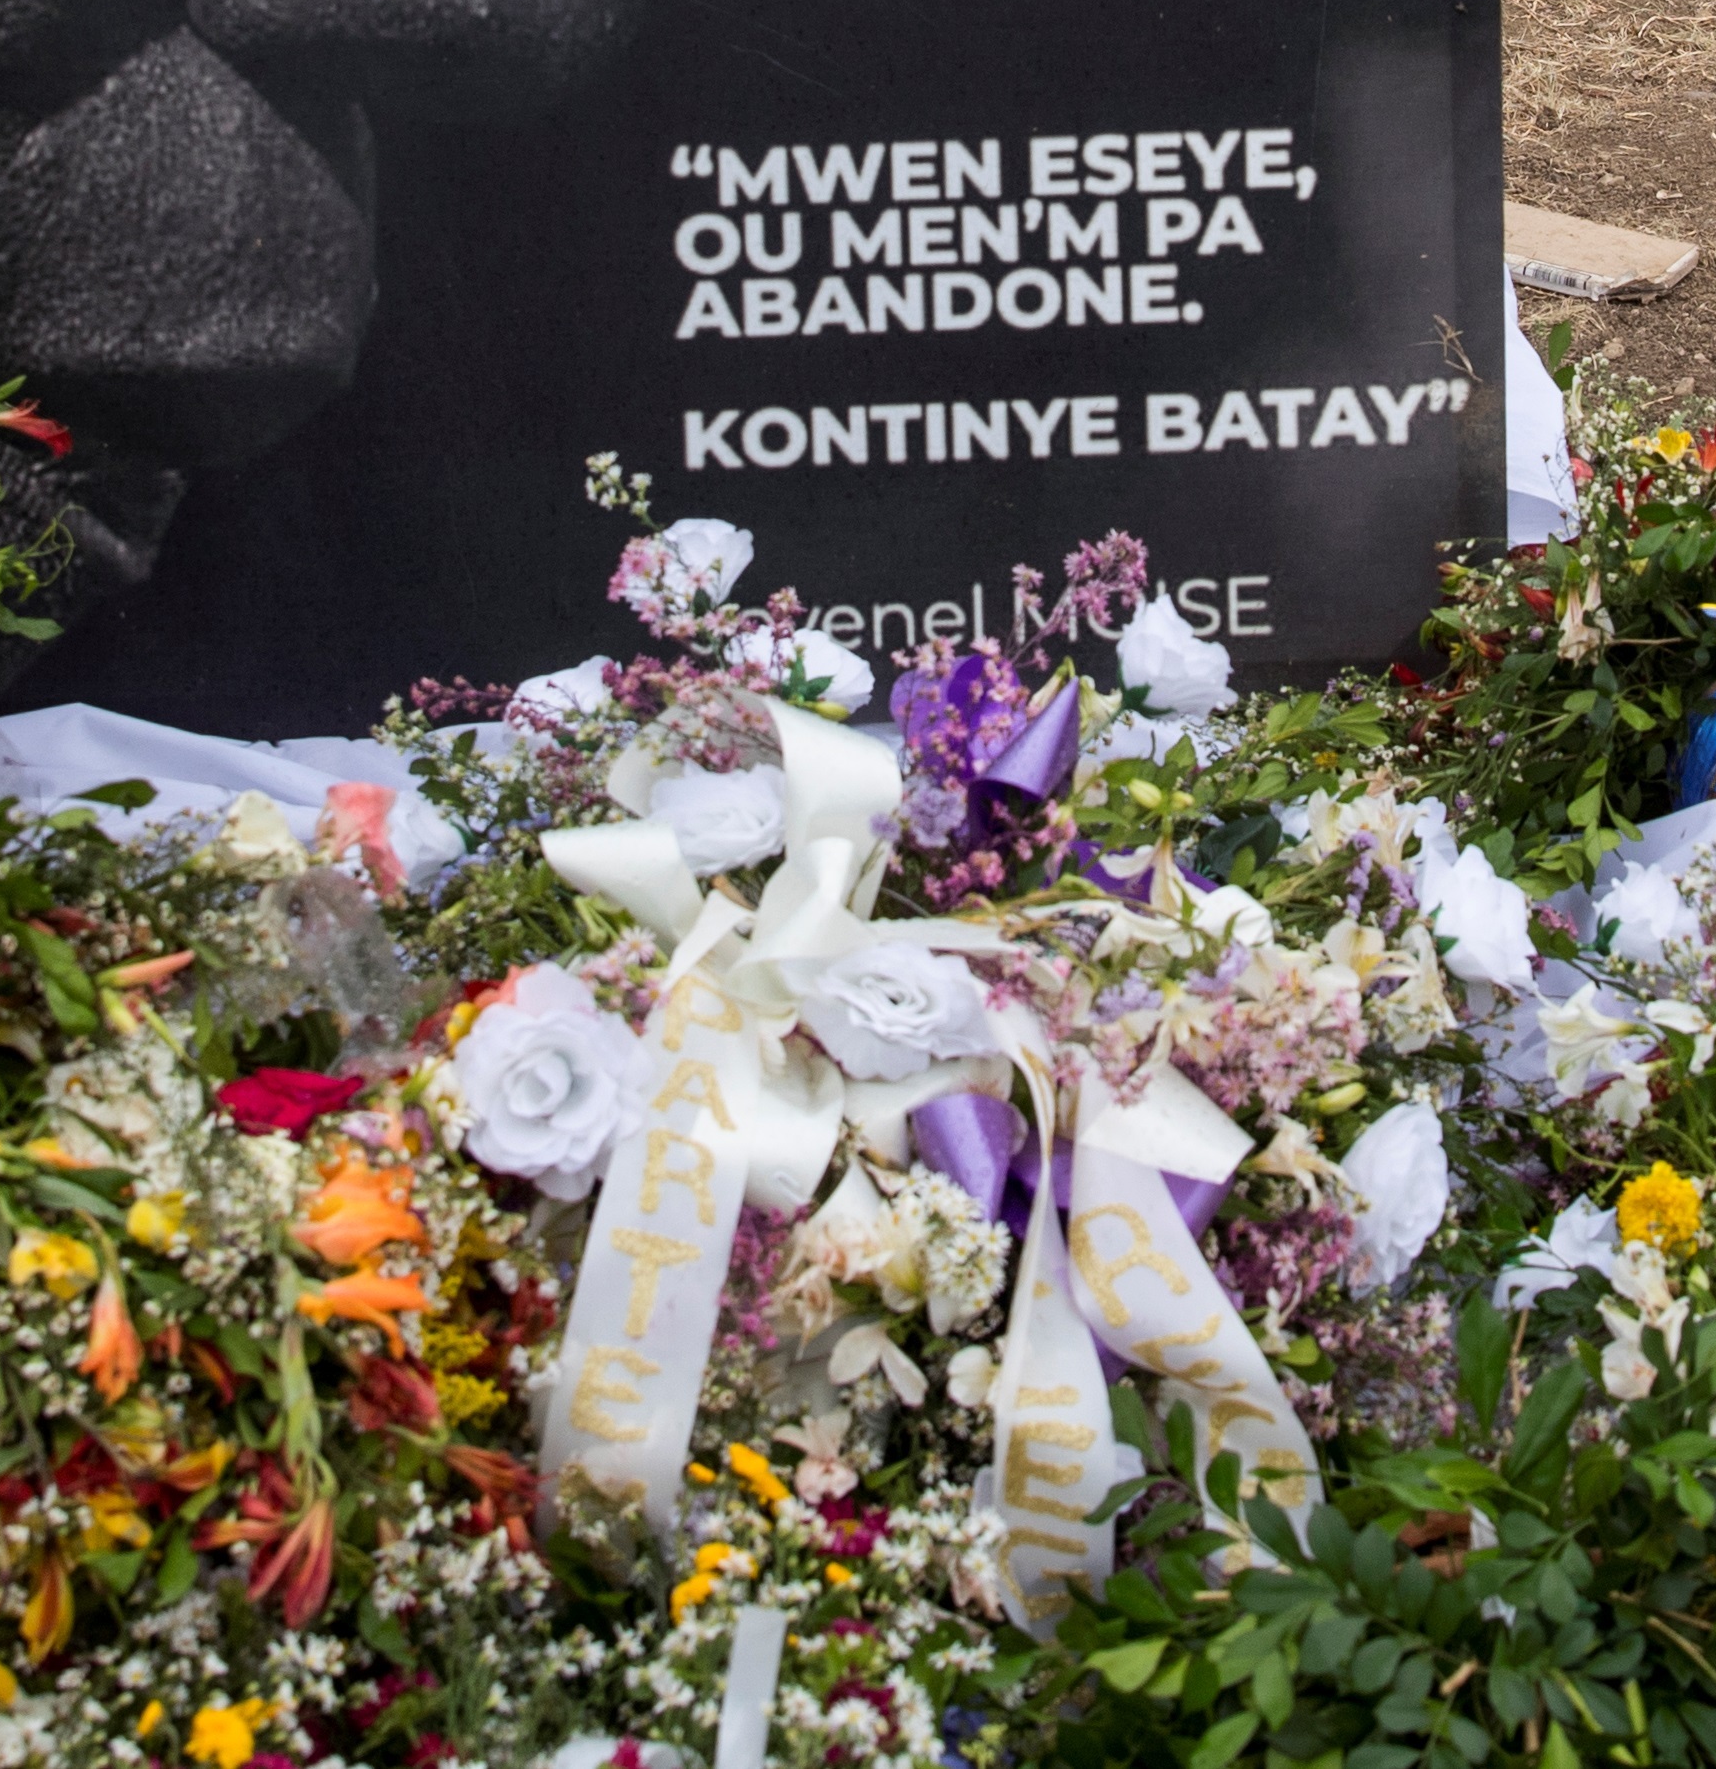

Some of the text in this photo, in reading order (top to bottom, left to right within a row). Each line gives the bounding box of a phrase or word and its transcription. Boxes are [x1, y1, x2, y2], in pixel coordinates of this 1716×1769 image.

[670, 128, 1318, 208] “MWEN ESEYE,
[674, 195, 1264, 276] OU MEN’M PA
[675, 263, 1205, 340] ABANDONE.
[683, 377, 1472, 470] KONTINYE BATAY”
